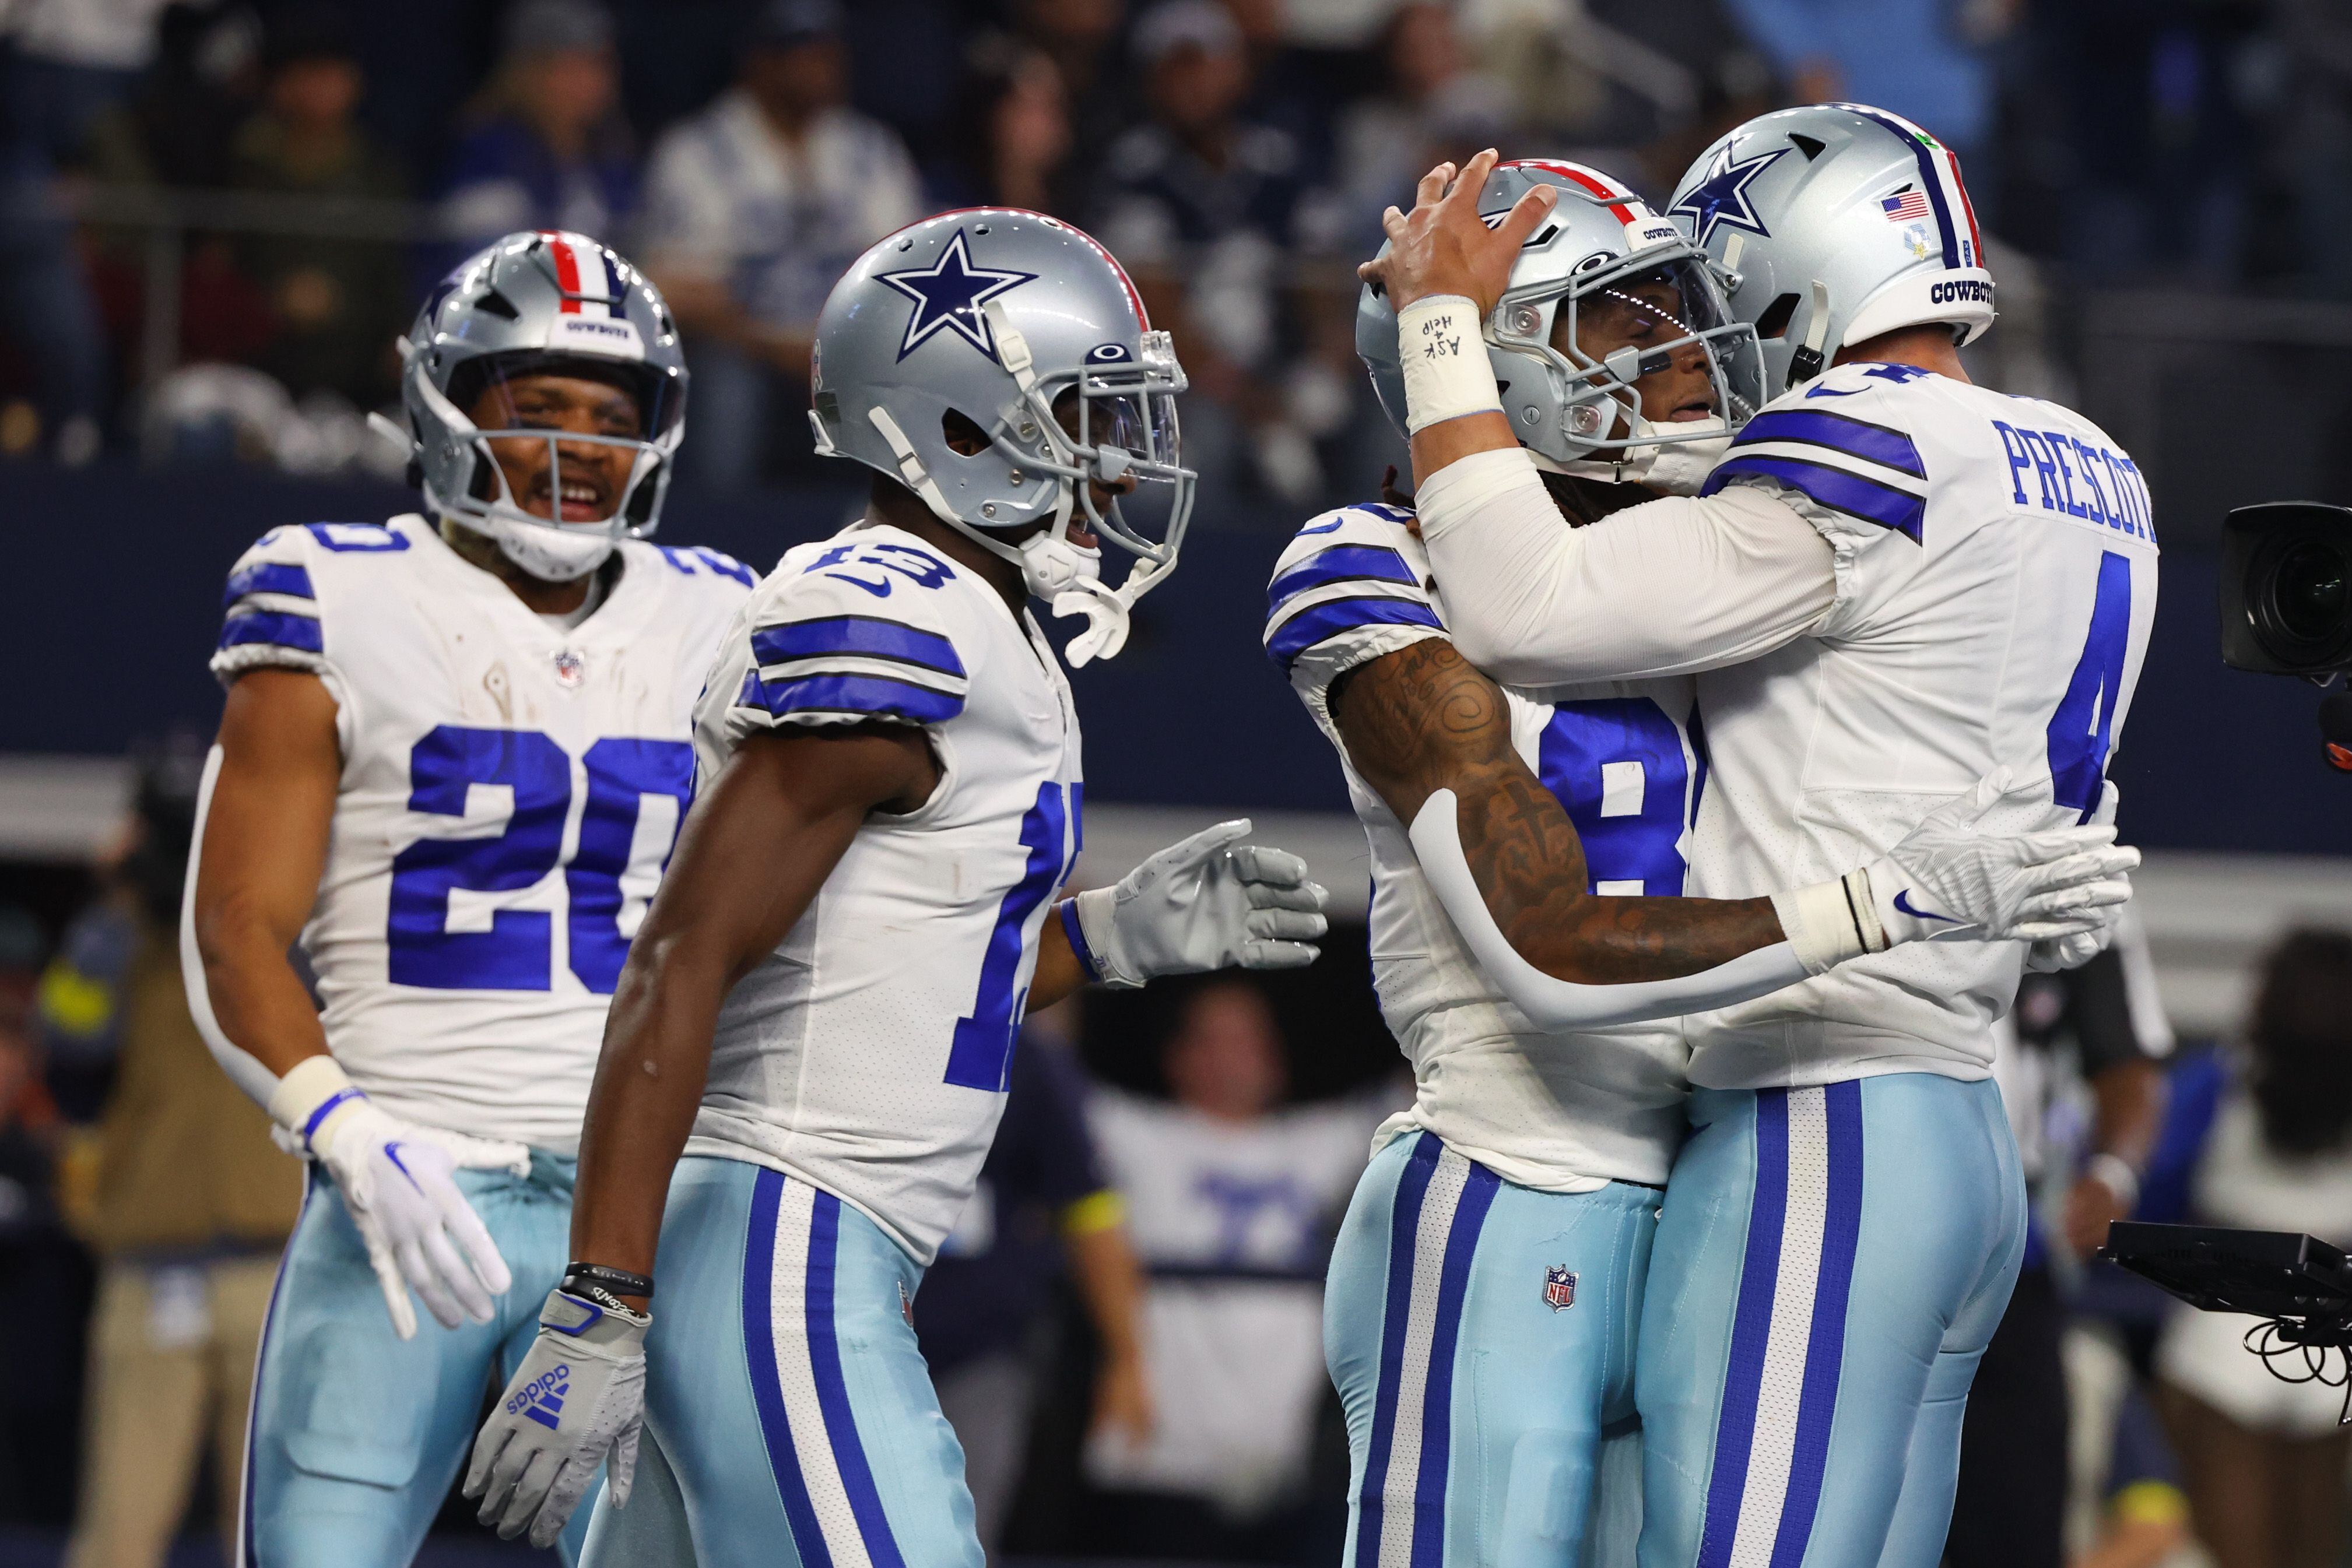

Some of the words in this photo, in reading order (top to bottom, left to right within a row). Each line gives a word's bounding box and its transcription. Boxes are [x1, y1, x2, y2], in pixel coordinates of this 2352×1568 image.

[1963, 241, 1972, 262] DAK
[1931, 280, 1993, 306] COWBOY
[1423, 316, 1451, 335] Help
[1991, 420, 2157, 543] PRESCOTT
[802, 544, 957, 590] 13
[2046, 550, 2132, 827] 4
[1538, 696, 1708, 897] 8
[387, 725, 698, 994] 20
[1548, 1284, 1571, 1304] NFL
[506, 1364, 570, 1415] adidas
